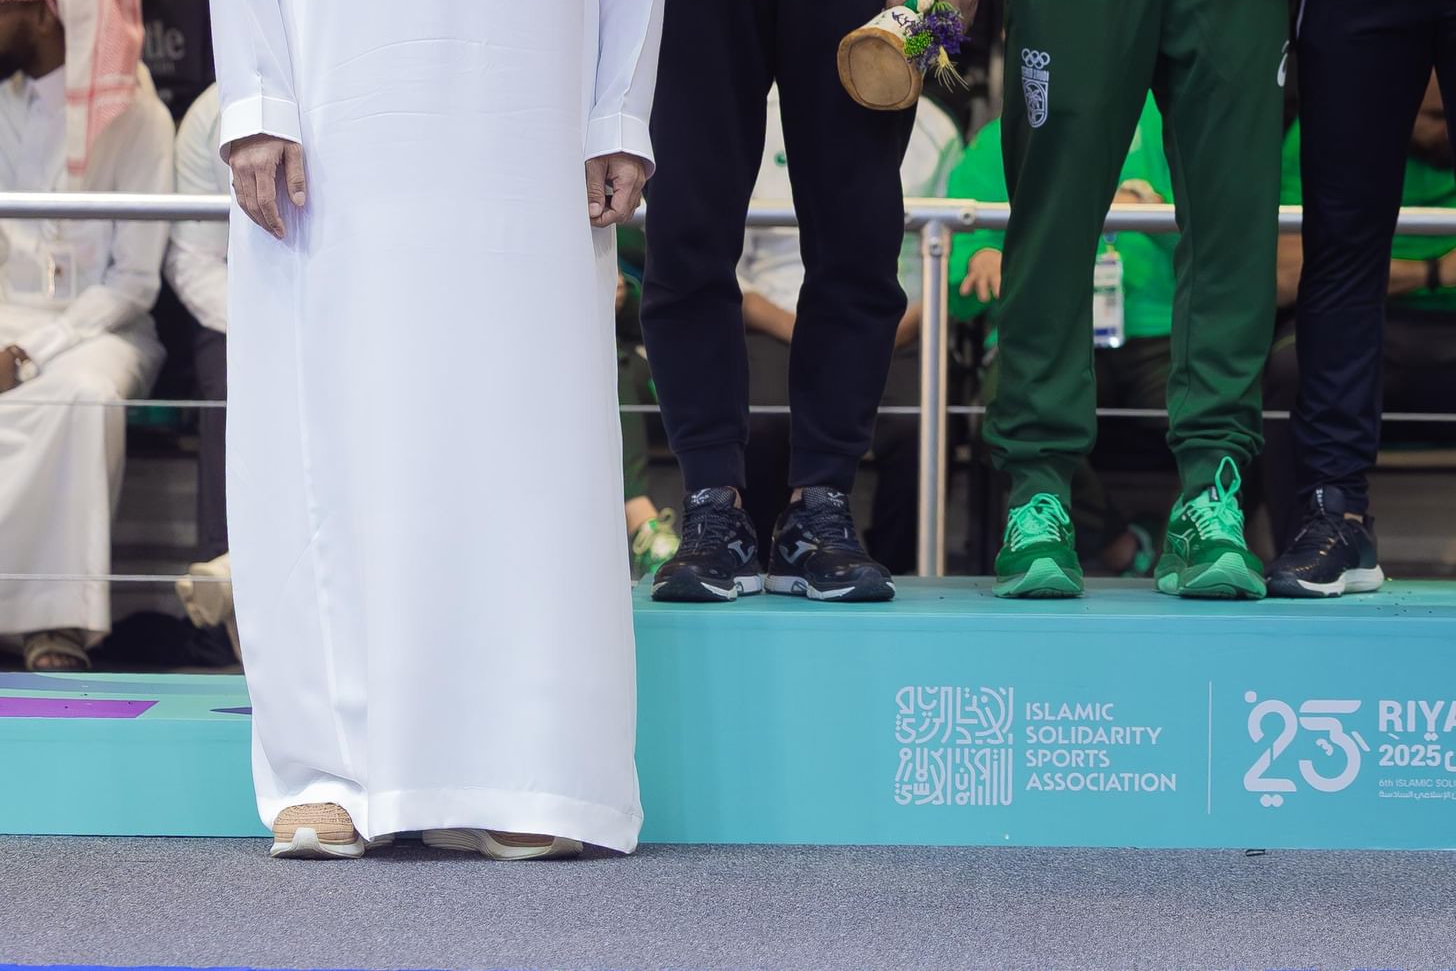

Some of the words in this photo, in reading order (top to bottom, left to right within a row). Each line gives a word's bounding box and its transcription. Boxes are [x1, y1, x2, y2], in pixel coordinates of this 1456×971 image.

[1025, 702, 1114, 721] ISLAMIC
[1025, 725, 1163, 745] SOLIDARITY
[1025, 749, 1111, 768] SPORTS
[1378, 744, 1442, 767] 2025
[1025, 773, 1177, 792] ASSOCIATION
[1379, 779, 1394, 788] 6th
[1396, 779, 1433, 788] ISLAMIC
